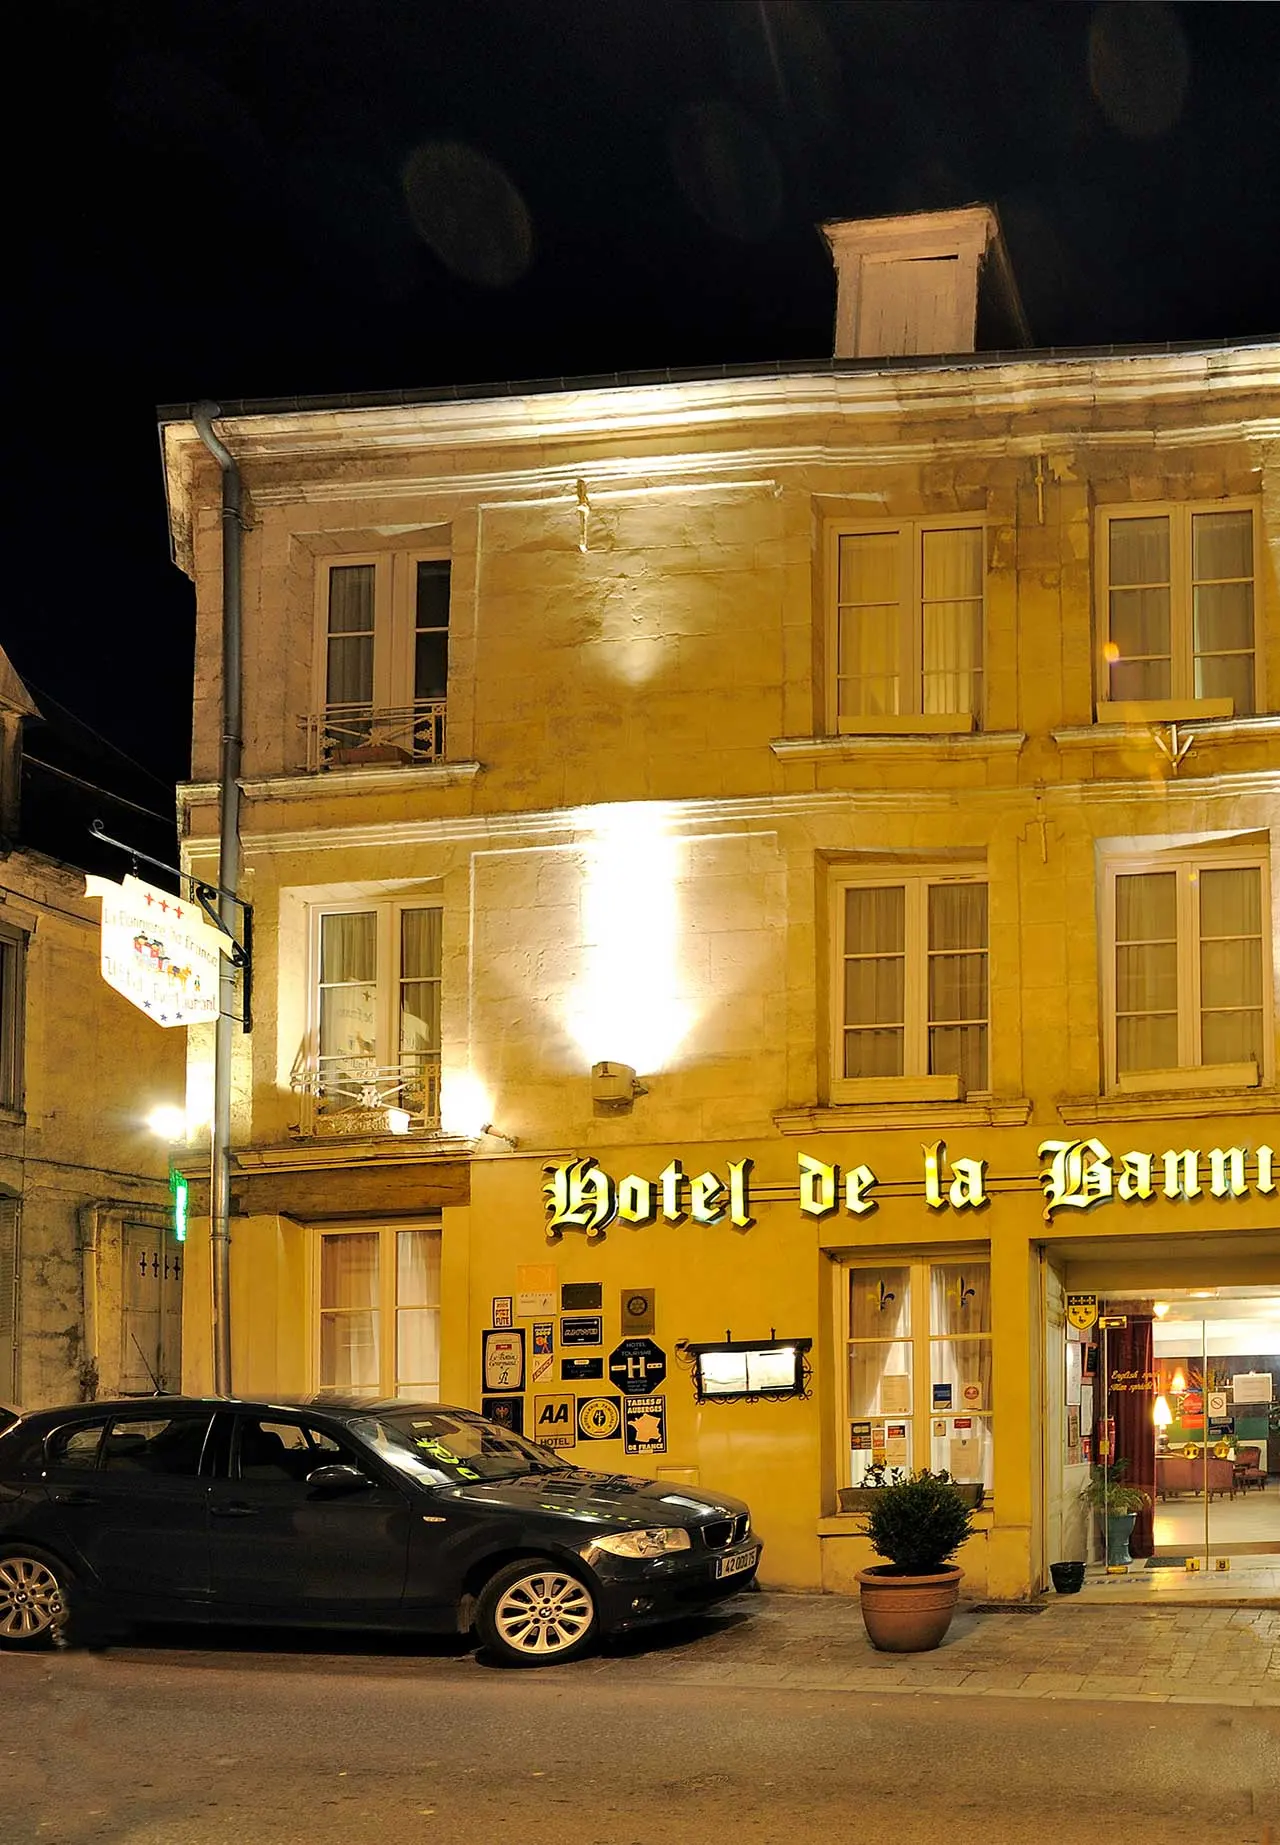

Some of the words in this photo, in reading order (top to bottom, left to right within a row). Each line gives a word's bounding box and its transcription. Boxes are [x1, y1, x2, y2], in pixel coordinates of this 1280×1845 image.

[541, 1156, 754, 1238] Hotel
[797, 1151, 878, 1217] de
[920, 1139, 988, 1210] la
[627, 1356, 647, 1378] H
[627, 1399, 655, 1407] TABLES
[627, 1406, 662, 1414] AUBERGES
[539, 1403, 568, 1425] AA
[540, 1438, 570, 1447] HOTEL
